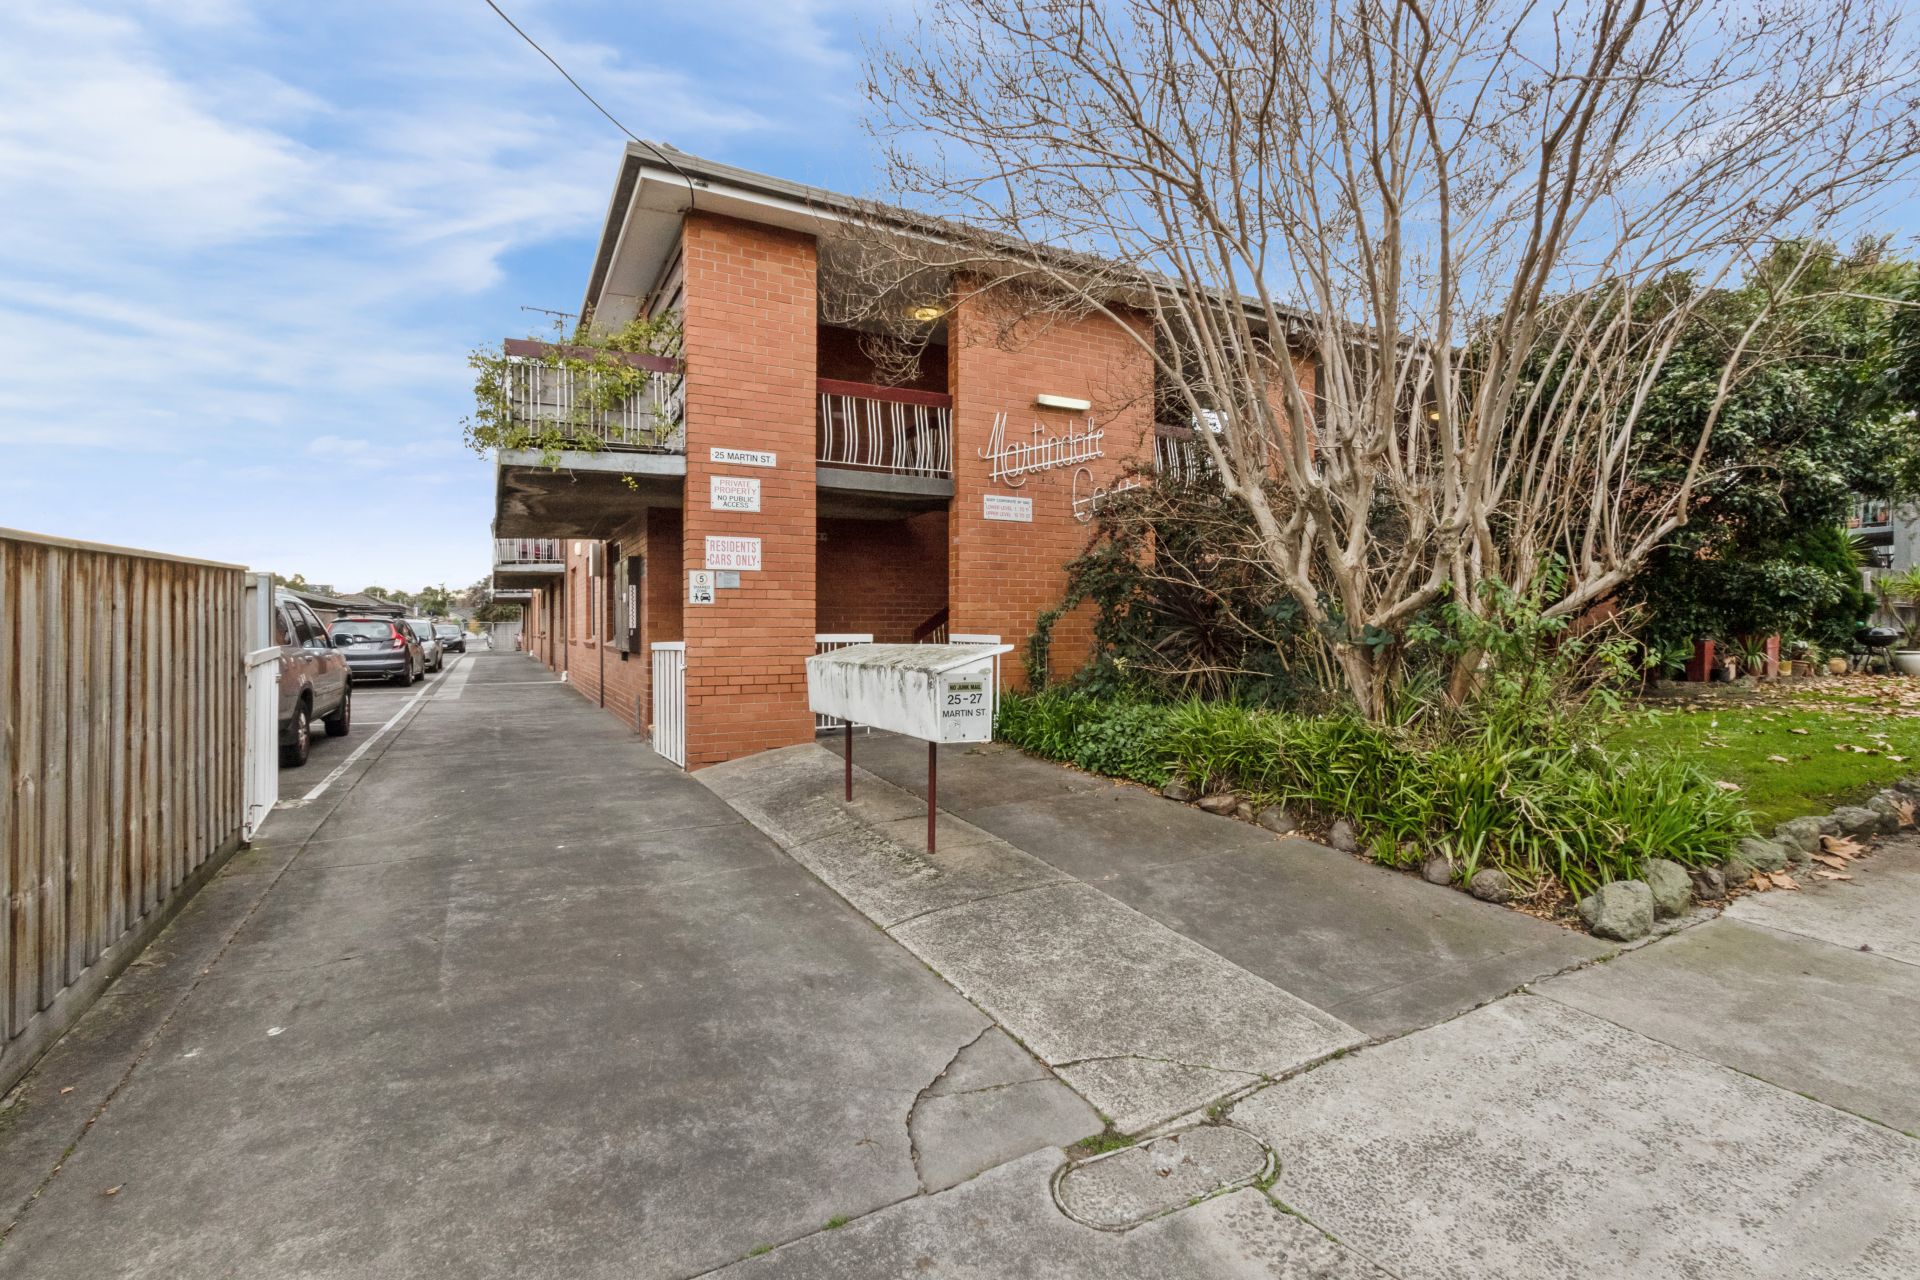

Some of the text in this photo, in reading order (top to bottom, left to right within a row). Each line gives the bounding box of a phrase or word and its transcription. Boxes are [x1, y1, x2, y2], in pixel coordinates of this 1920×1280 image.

[714, 451, 725, 459] 25
[727, 452, 758, 462] MARTIN
[719, 479, 750, 488] PRIVATE
[714, 486, 757, 495] PROPERTY
[729, 495, 754, 503] PUBLIC
[709, 540, 757, 553] RESIDENTS
[709, 553, 757, 567] CARS ONLY
[942, 709, 974, 718] MARTIN
